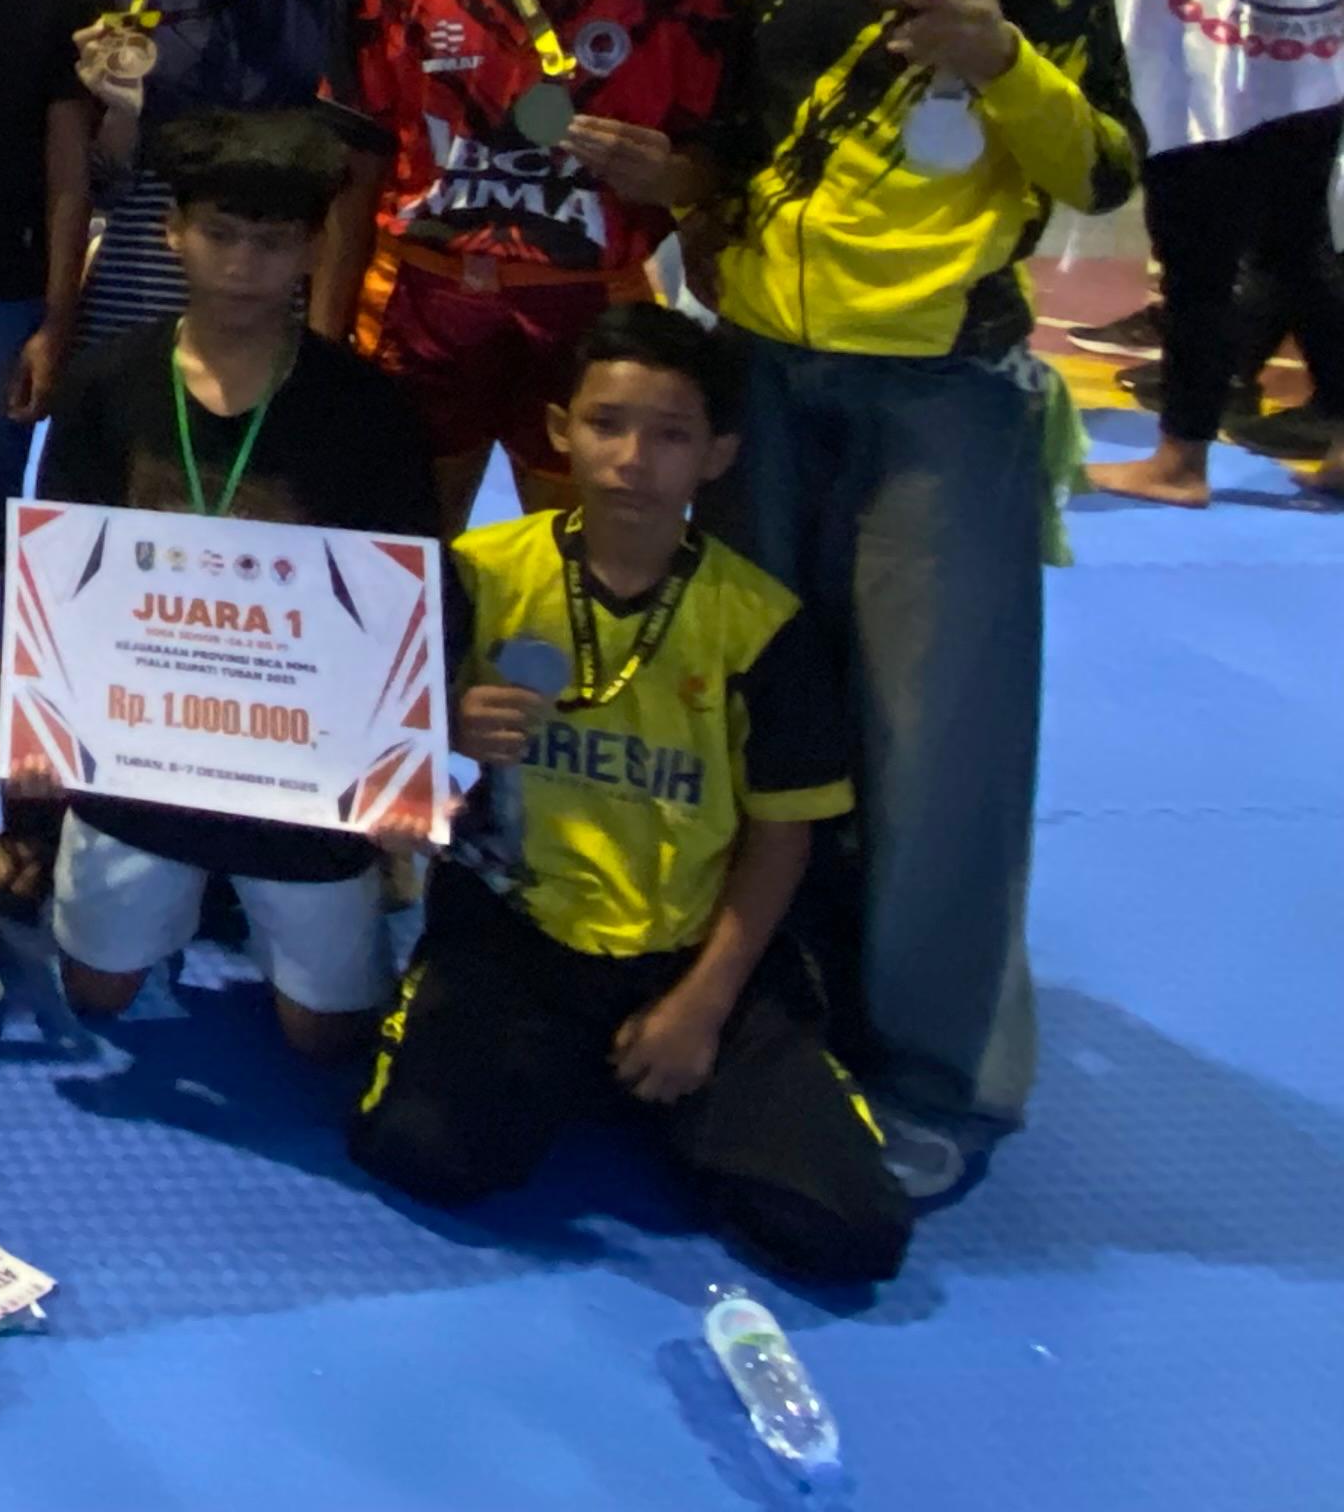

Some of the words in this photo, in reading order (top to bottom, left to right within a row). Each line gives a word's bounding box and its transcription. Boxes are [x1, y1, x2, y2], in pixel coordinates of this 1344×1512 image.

[131, 591, 272, 636] JUARA
[285, 608, 303, 640] 1
[108, 683, 153, 729] Rp.
[163, 691, 331, 751] 1.000.000,-
